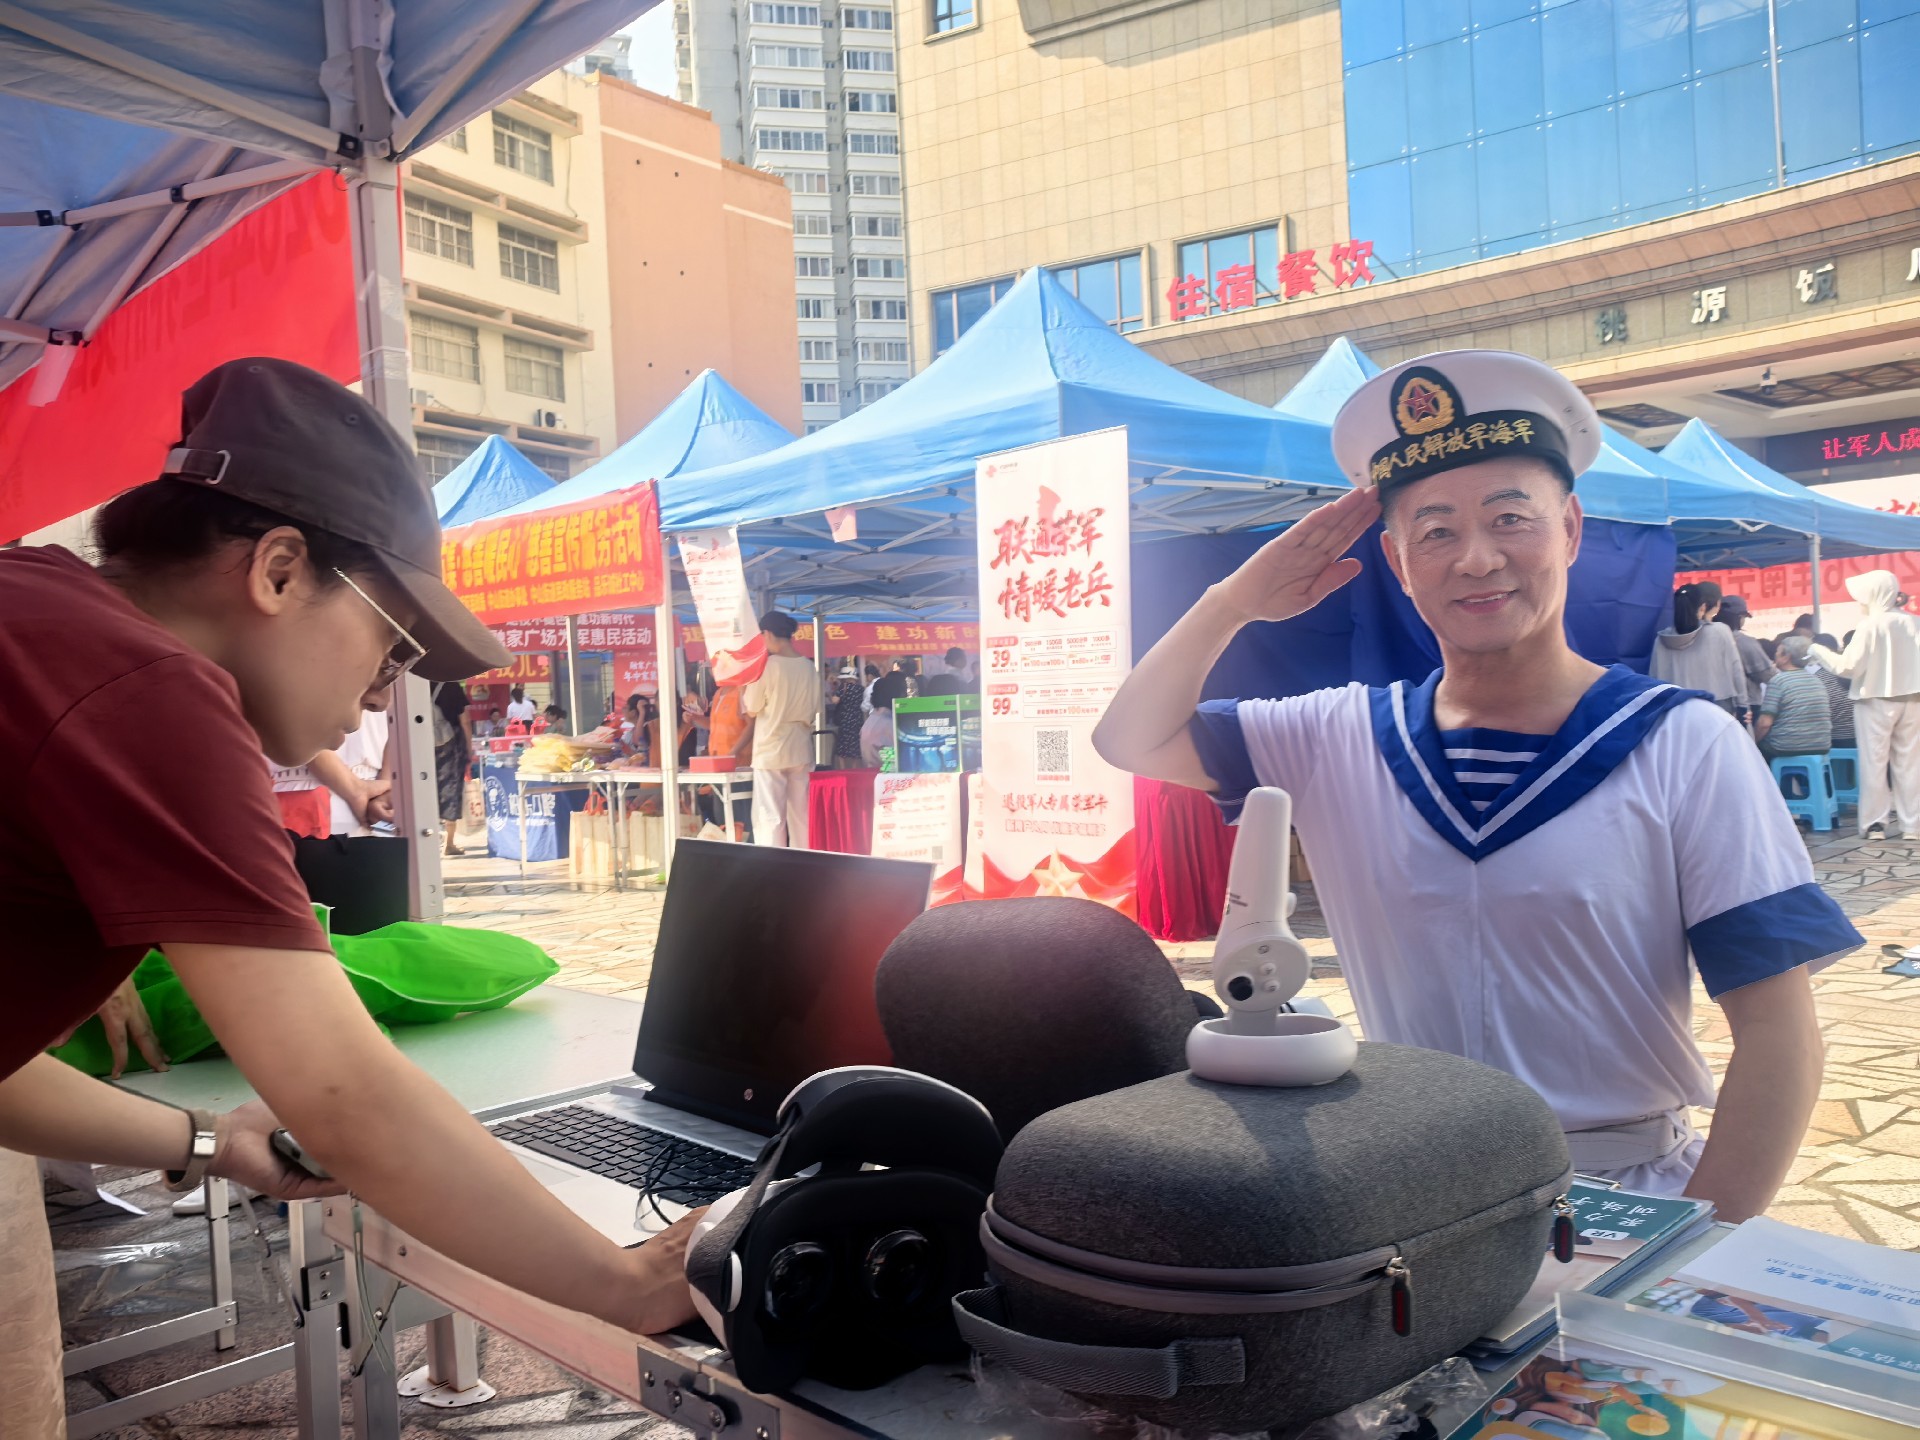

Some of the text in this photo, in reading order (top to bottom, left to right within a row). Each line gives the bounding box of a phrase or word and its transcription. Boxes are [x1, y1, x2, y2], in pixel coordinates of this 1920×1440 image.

[990, 507, 1105, 570] 联通荣军
[997, 560, 1114, 623] 情暖老兵
[992, 650, 1010, 668] 39
[993, 697, 1011, 716] 99
